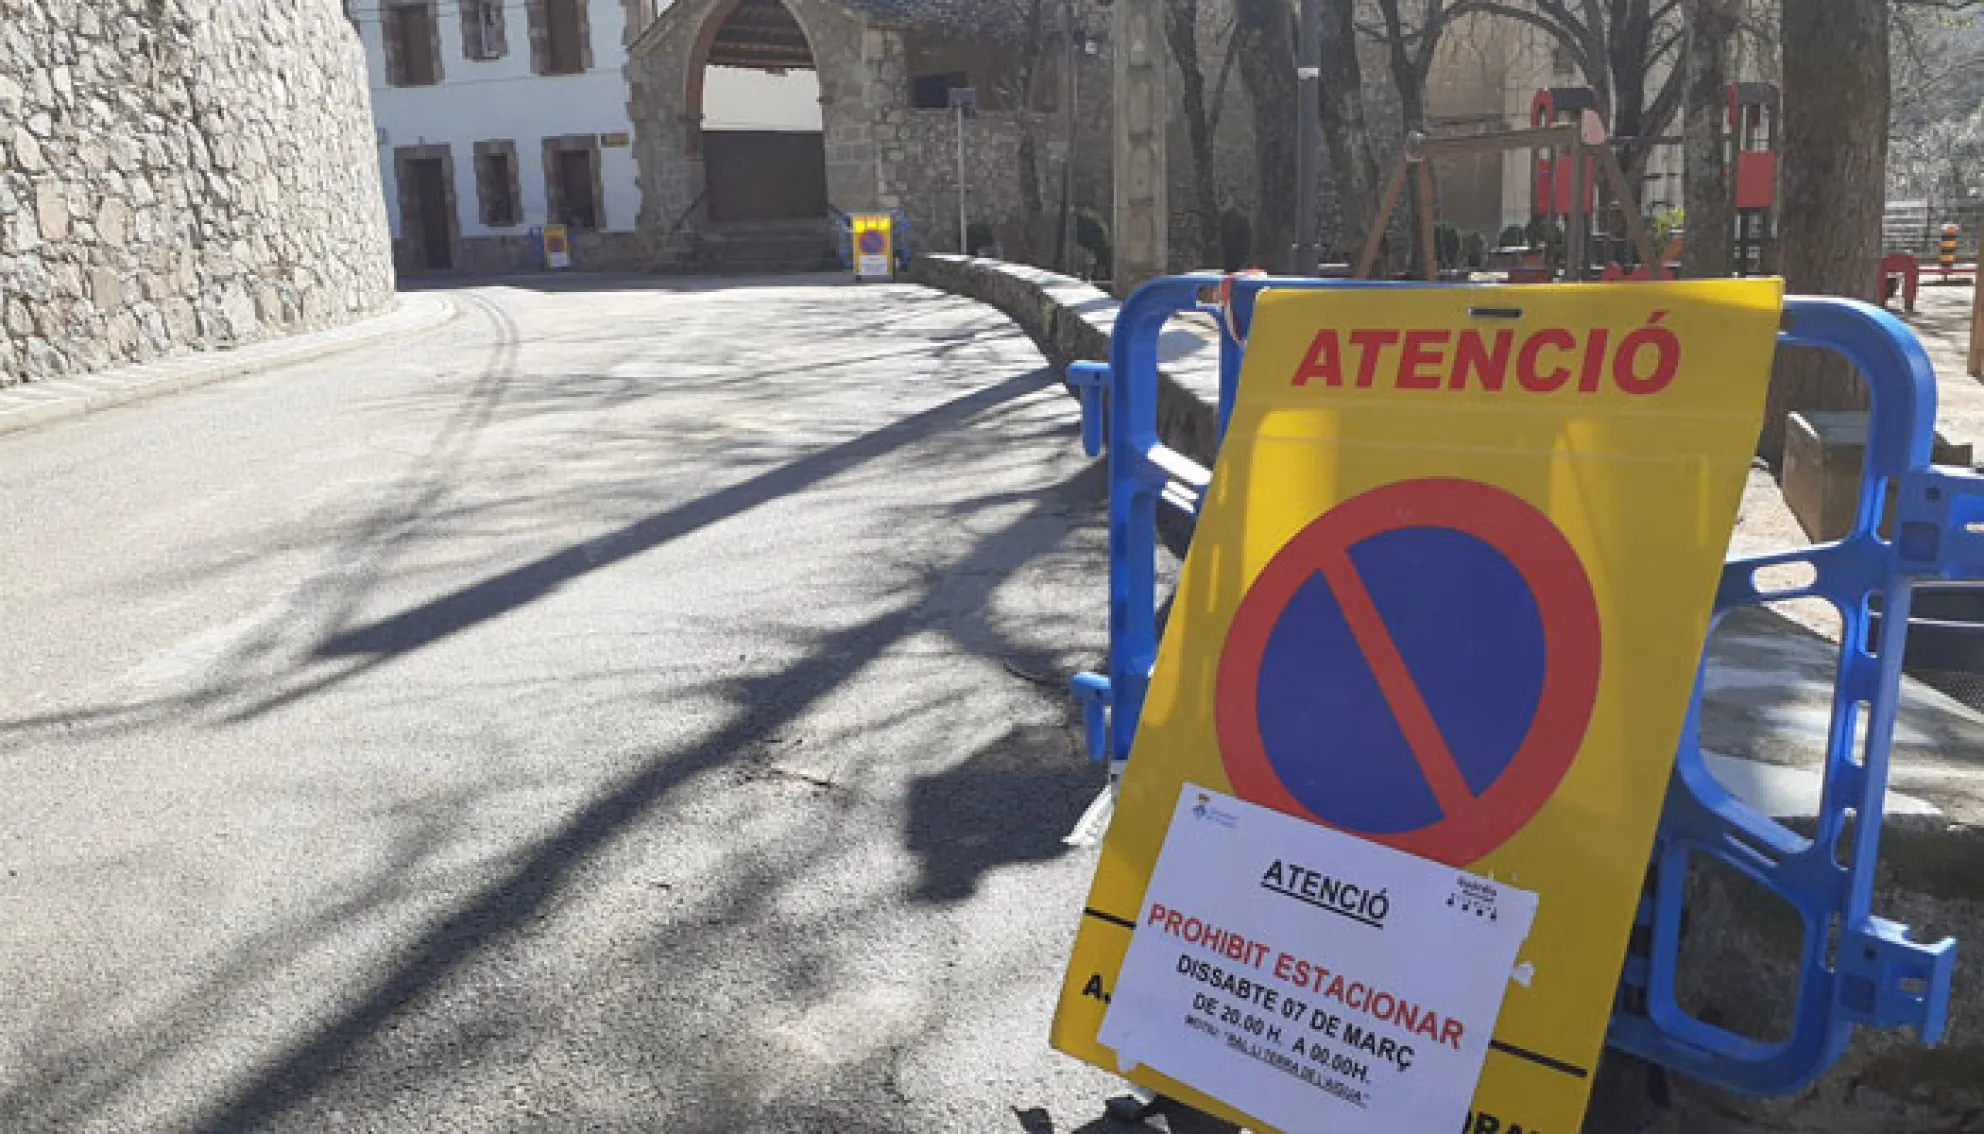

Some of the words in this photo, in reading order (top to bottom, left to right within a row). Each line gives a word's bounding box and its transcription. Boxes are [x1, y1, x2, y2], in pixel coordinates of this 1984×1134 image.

[1291, 309, 1681, 395] ATENCIÓ
[1261, 859, 1390, 921] ATENCIÓ
[1148, 903, 1270, 970] PROHIBIT
[1273, 952, 1465, 1050] ESTACIONAR
[1176, 953, 1279, 1012] DISSABTE
[1281, 997, 1307, 1022] 07
[1309, 1009, 1341, 1038] DE
[1343, 1023, 1415, 1073] MARÇ
[1193, 992, 1219, 1016] DE
[1220, 1004, 1265, 1036] 20.00
[1292, 1036, 1306, 1056] A
